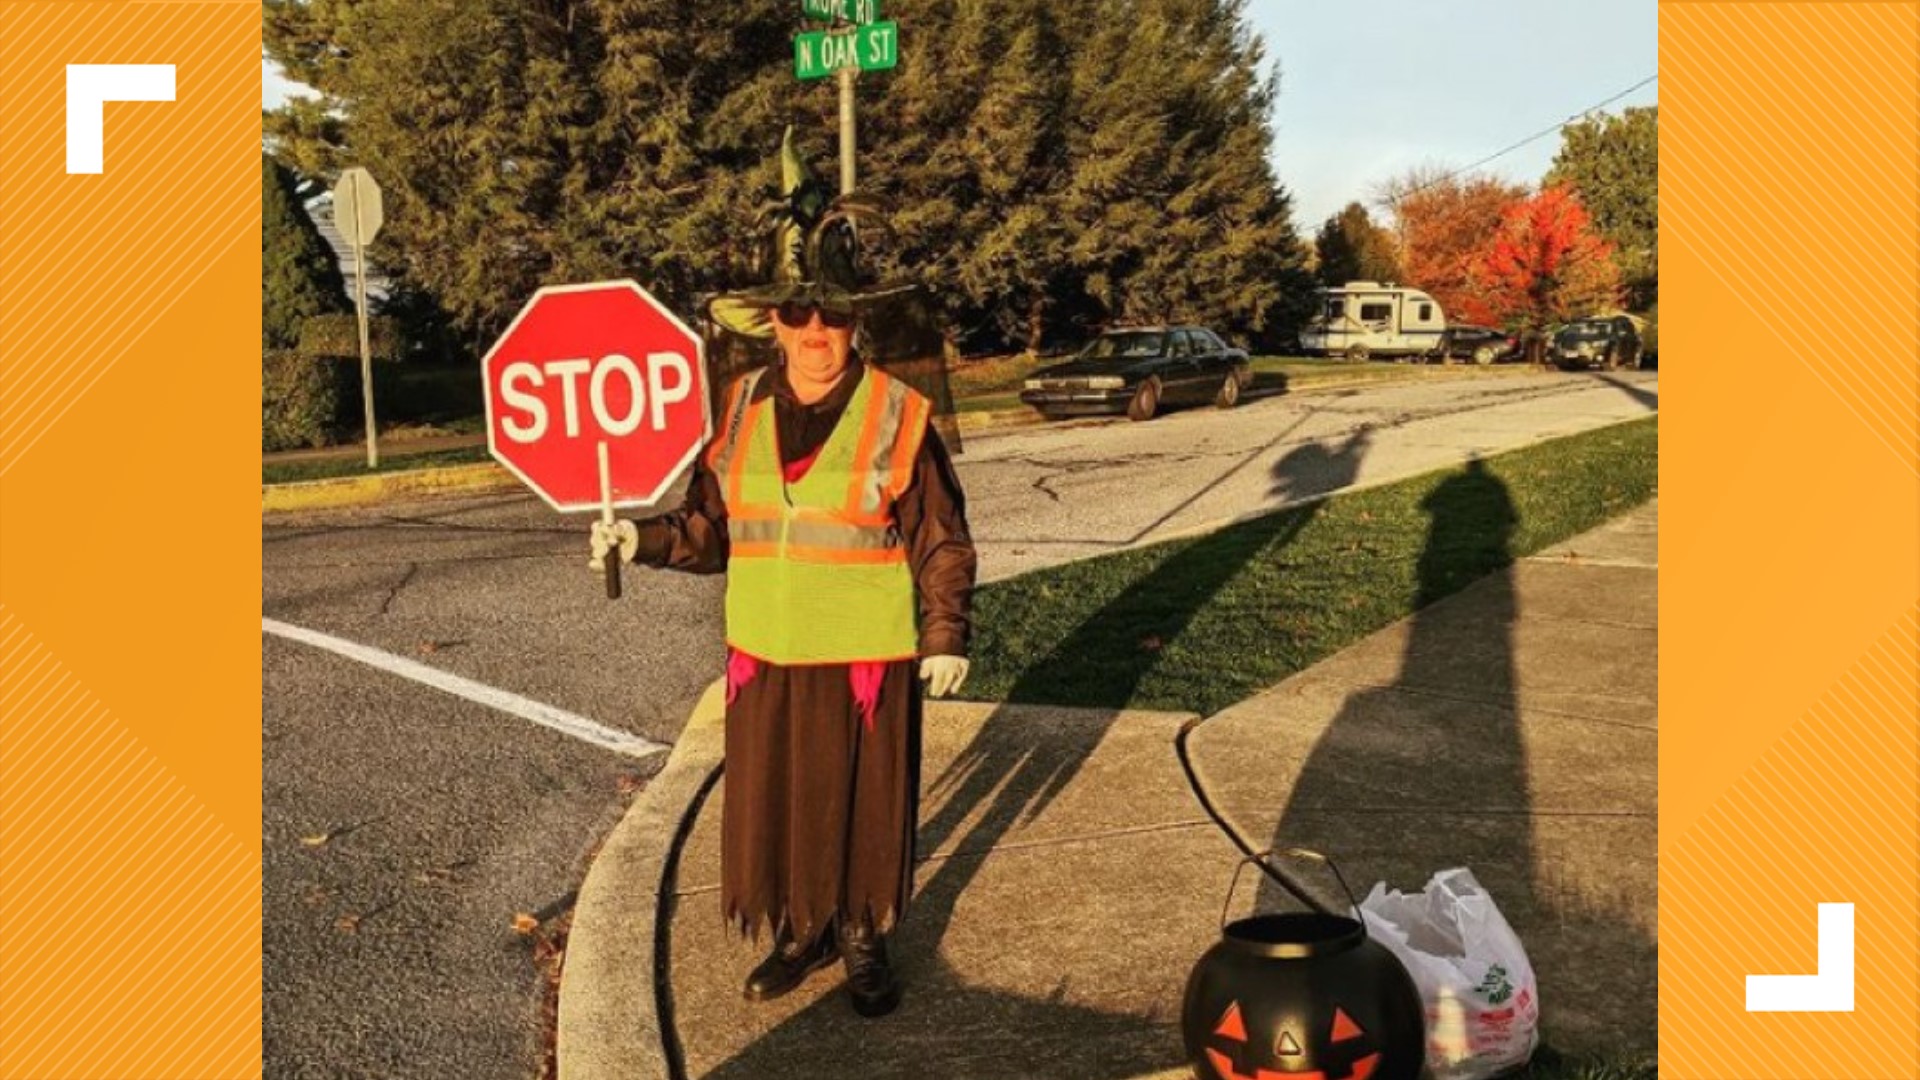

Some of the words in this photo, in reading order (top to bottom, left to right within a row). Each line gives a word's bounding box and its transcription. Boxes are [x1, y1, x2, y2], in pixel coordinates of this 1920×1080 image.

[799, 41, 812, 71] N
[821, 34, 859, 69] OAK
[869, 30, 890, 63] ST
[500, 351, 692, 443] STOP
